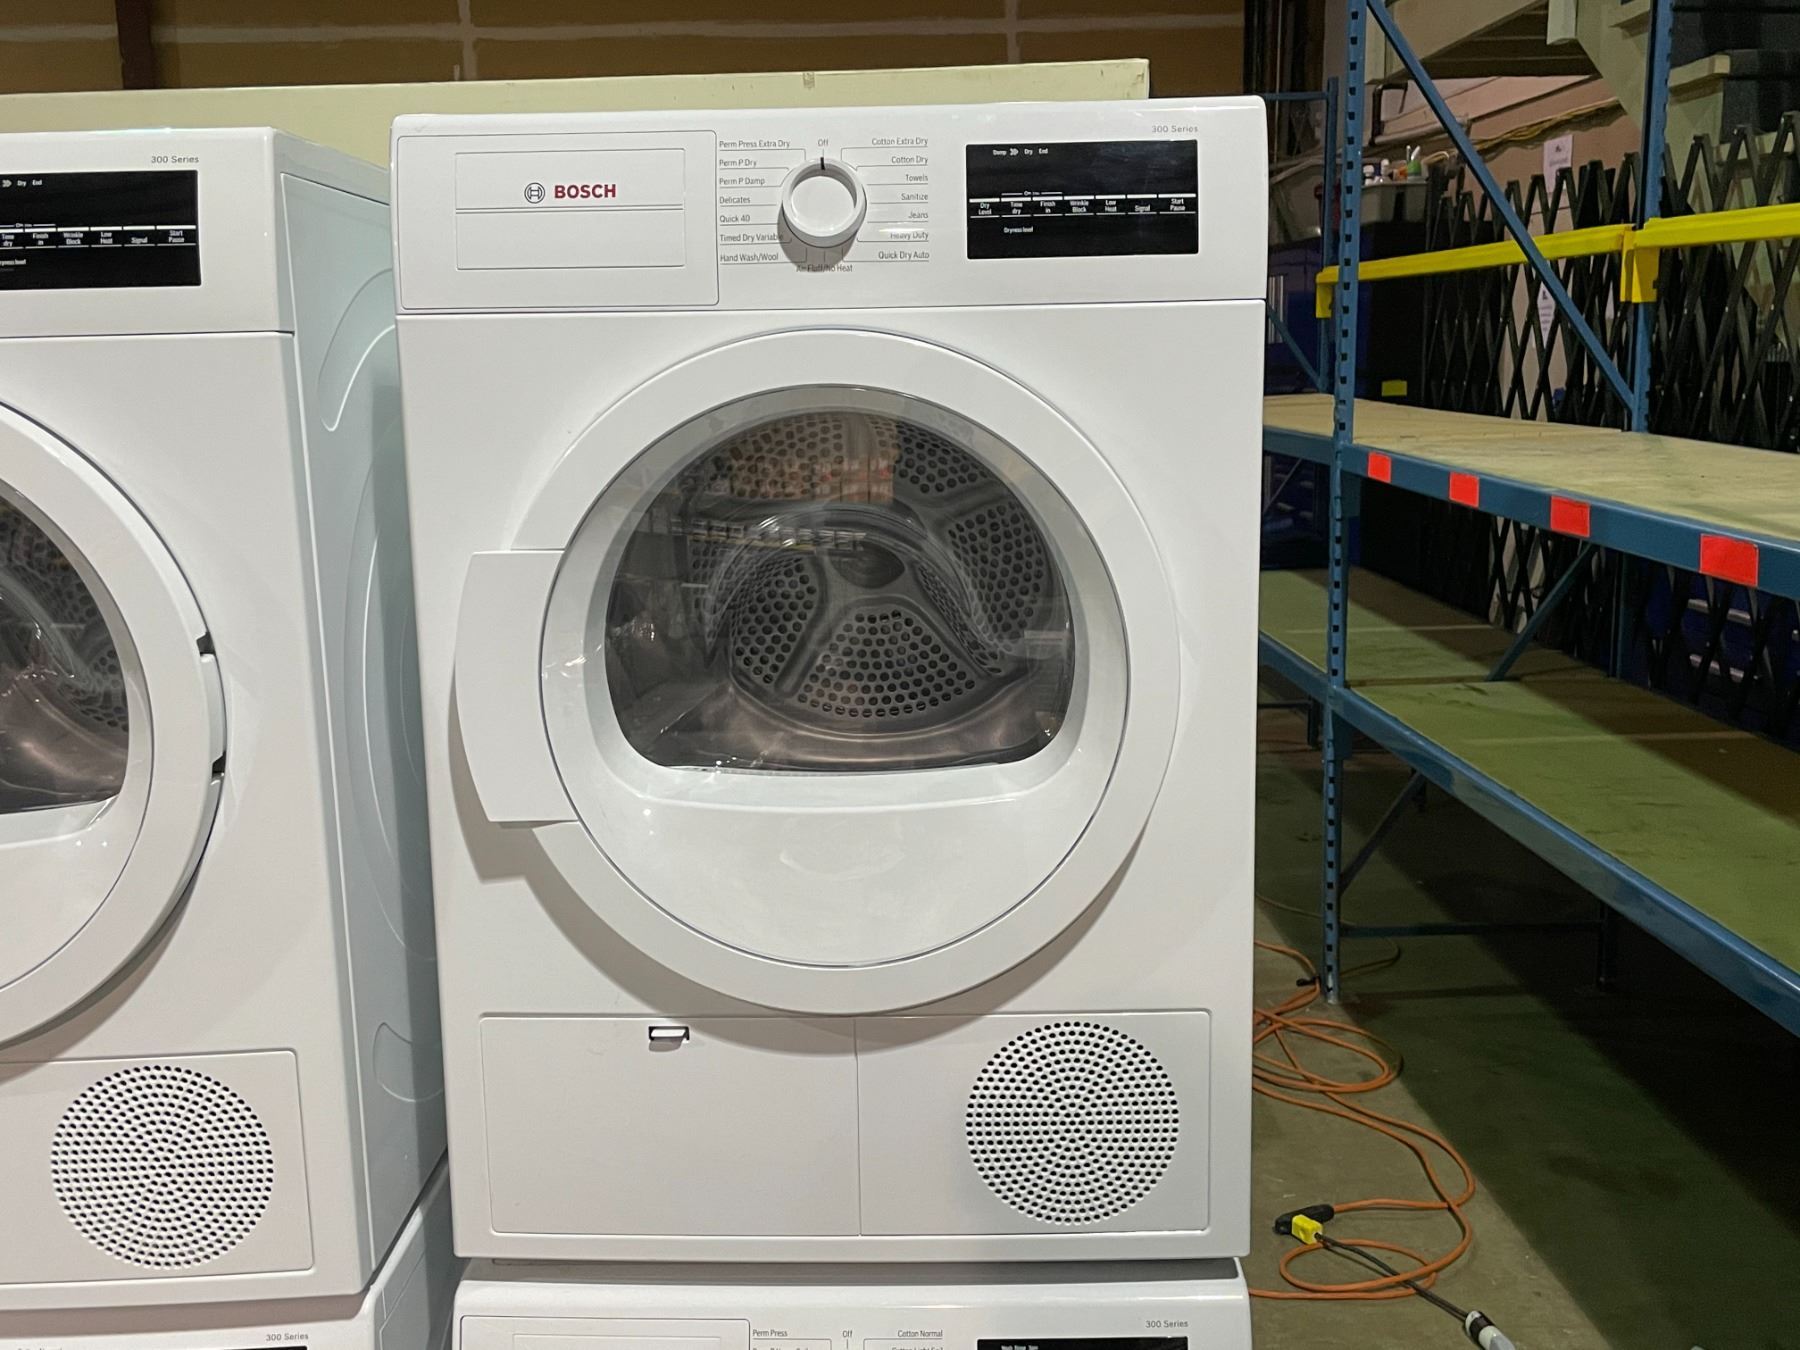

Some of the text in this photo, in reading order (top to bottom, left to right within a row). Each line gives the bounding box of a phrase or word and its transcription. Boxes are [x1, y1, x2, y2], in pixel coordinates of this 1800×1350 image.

[759, 140, 776, 148] Extra
[778, 140, 790, 148] Dry
[818, 138, 828, 146] Off
[916, 136, 928, 146] Dry
[151, 156, 200, 164] 300 Series
[744, 158, 757, 168] Dry
[916, 155, 928, 165] Dry
[744, 177, 766, 186] Damp
[906, 174, 928, 182] Towels
[554, 184, 616, 198] BOSCH
[720, 234, 741, 242] Timed
[742, 234, 754, 242] Dry
[912, 232, 928, 240] Duty
[739, 253, 778, 262] Wash/Wool
[878, 250, 930, 260] Quick Dry Auto
